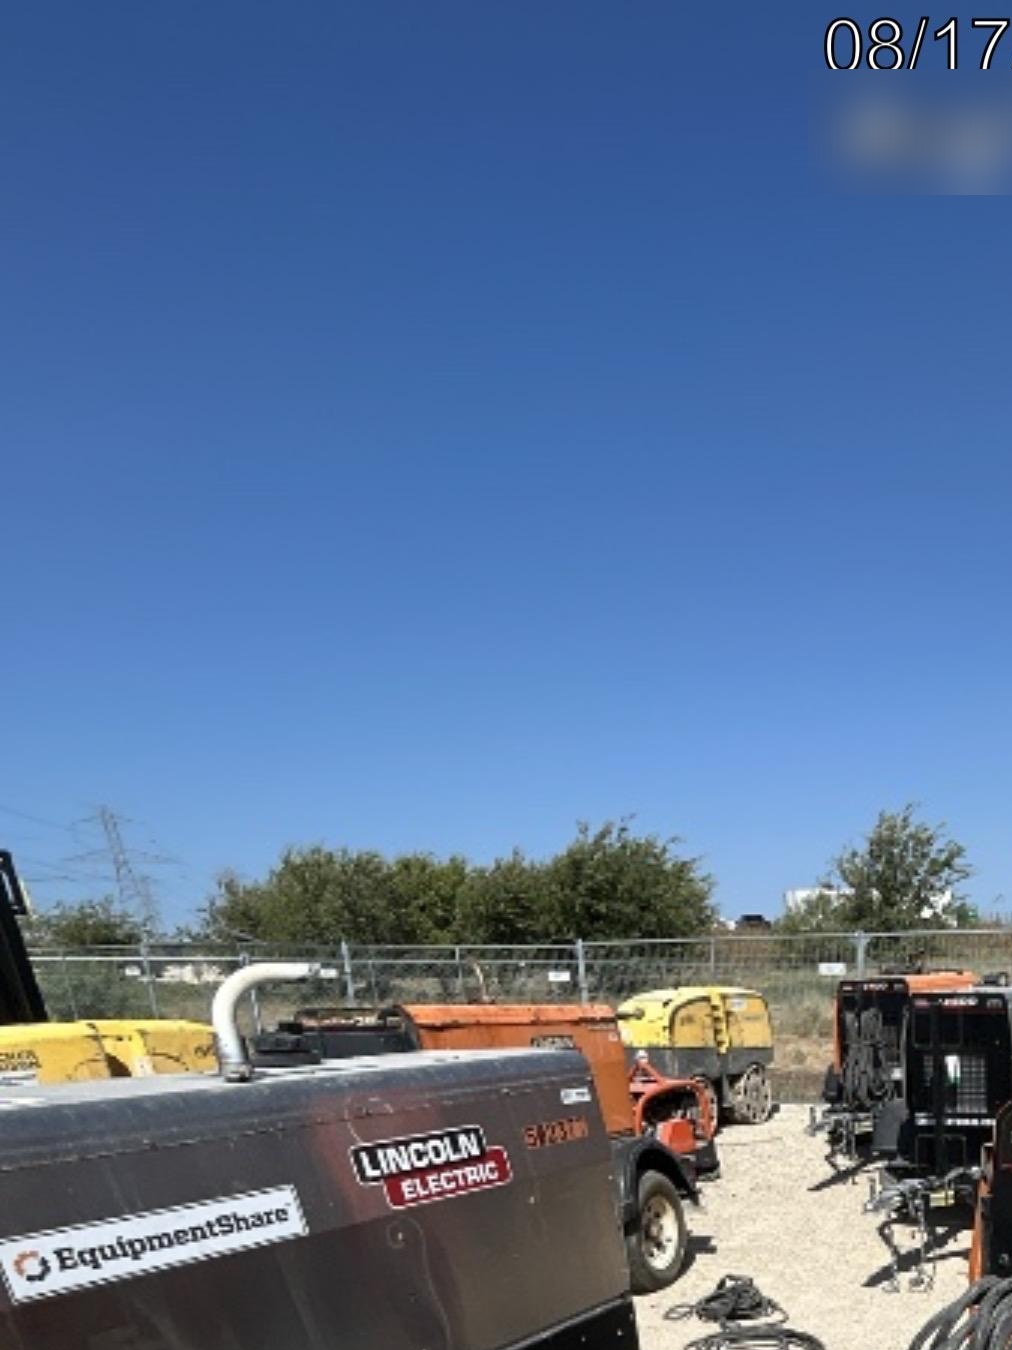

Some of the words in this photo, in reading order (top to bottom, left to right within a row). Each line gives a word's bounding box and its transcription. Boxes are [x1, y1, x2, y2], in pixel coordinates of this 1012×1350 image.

[359, 1132, 482, 1178] LINCOLN
[400, 1161, 500, 1200] ELECTRIC
[52, 1205, 290, 1272] EquipmentShare
